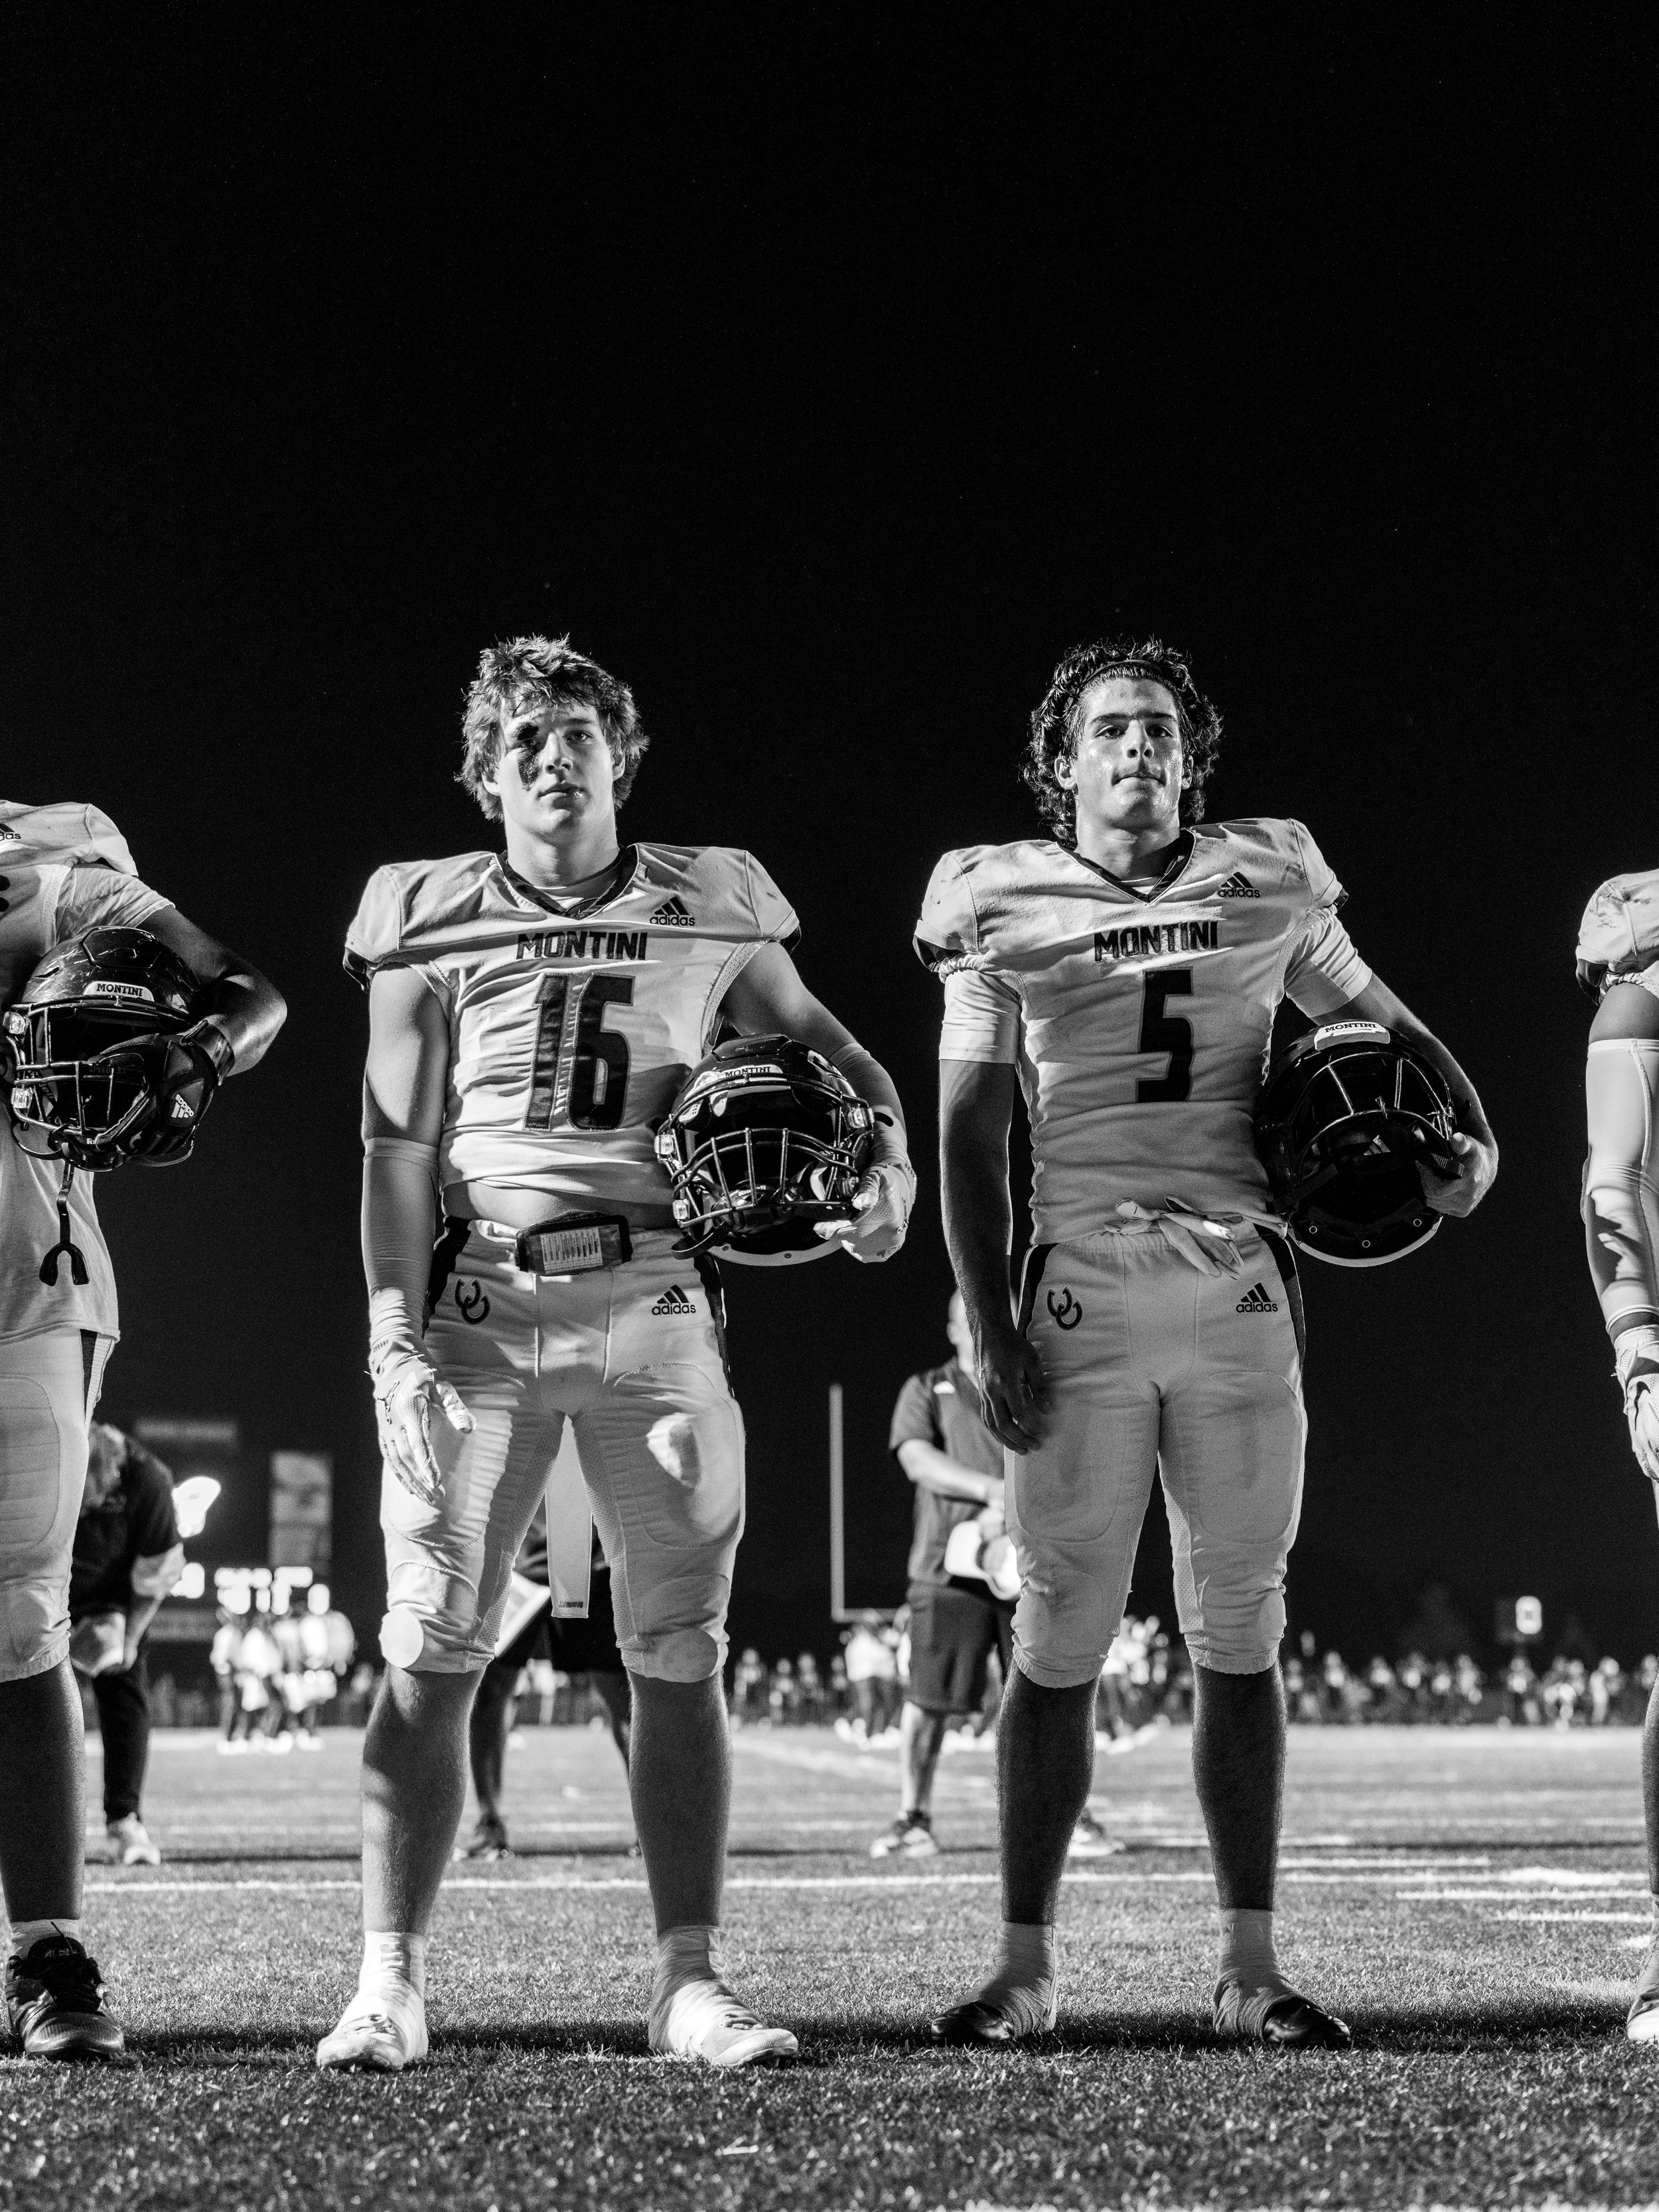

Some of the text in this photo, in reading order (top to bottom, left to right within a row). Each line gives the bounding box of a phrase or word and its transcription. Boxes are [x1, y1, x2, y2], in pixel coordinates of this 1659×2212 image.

[1218, 887, 1260, 897] adidas
[649, 914, 695, 926] adidas
[516, 930, 648, 960] MONTINI
[1094, 920, 1218, 962] MONTINI
[96, 984, 143, 997] MONTINI
[1135, 966, 1193, 1103] 5
[1325, 1023, 1378, 1033] MONTINI
[523, 972, 636, 1132] 16
[725, 1067, 770, 1076] MONTINI
[175, 1094, 194, 1117] adidas
[652, 1302, 696, 1315] adidas
[1236, 1301, 1278, 1313] adidas
